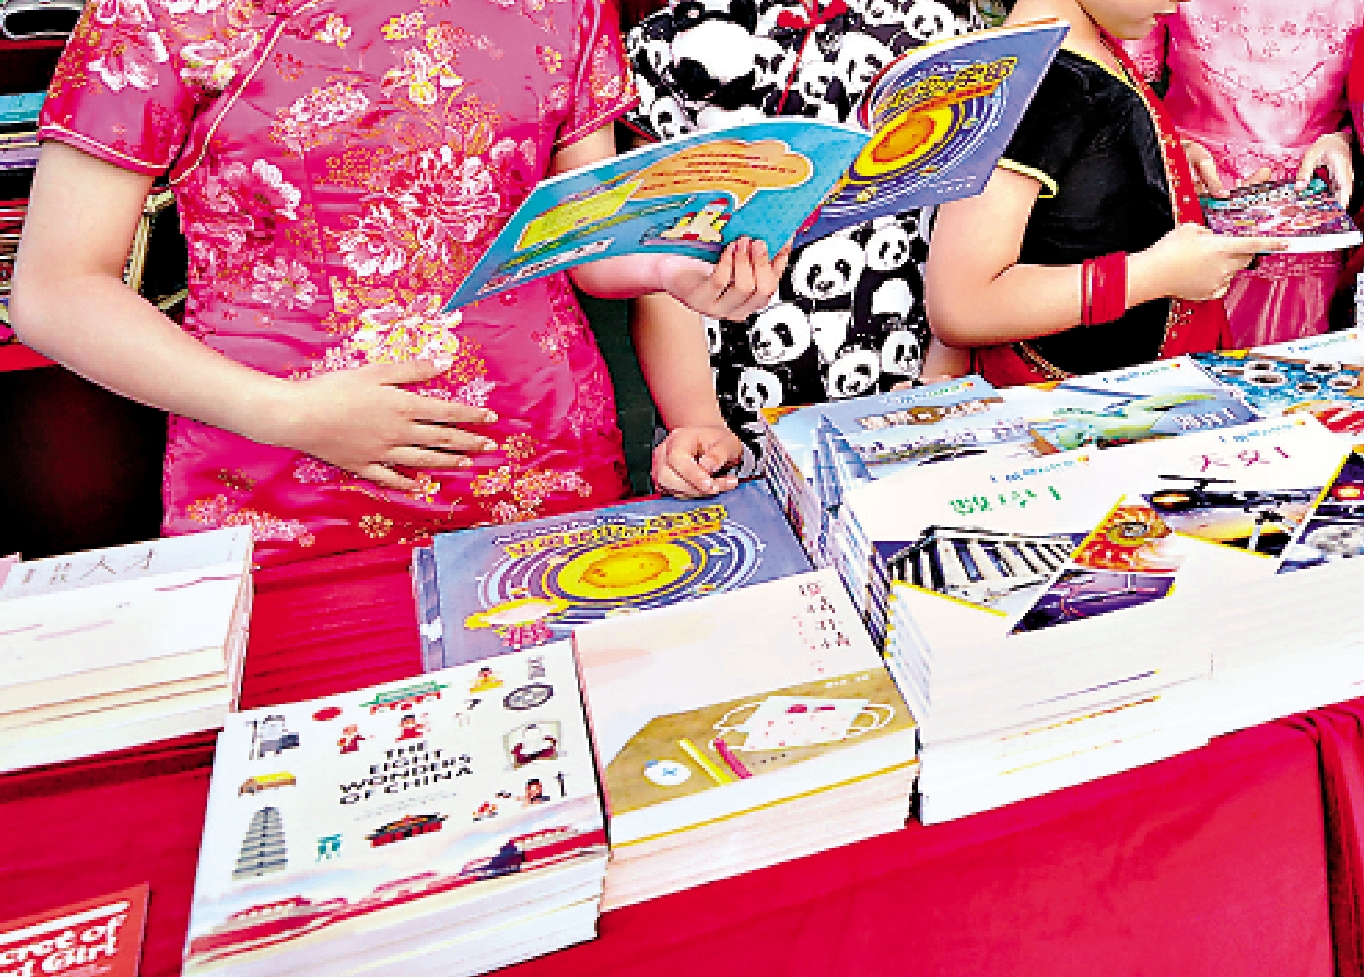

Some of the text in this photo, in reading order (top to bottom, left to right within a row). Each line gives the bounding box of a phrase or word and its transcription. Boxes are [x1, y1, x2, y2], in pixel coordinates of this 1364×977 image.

[369, 749, 444, 775] EIGHT
[384, 741, 428, 760] THE
[339, 754, 473, 793] WONDERS
[339, 769, 474, 805] OF CHINA
[42, 925, 117, 973] Girl
[80, 914, 127, 957] of
